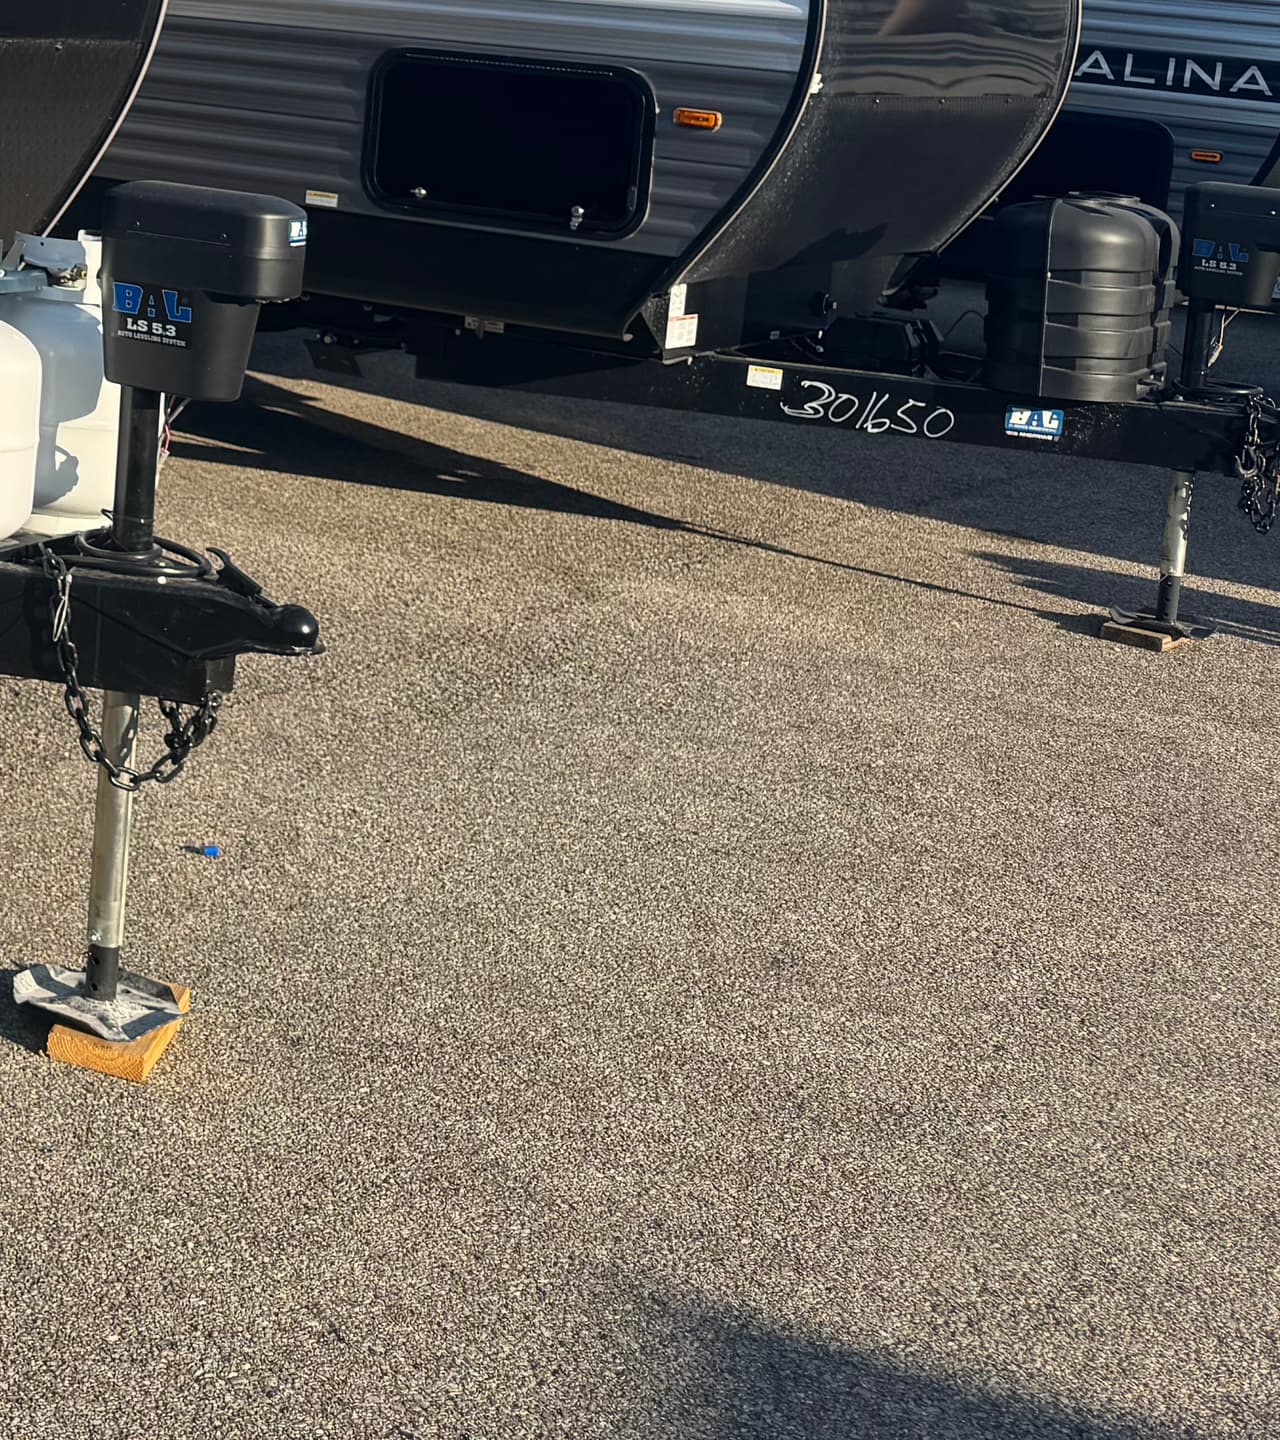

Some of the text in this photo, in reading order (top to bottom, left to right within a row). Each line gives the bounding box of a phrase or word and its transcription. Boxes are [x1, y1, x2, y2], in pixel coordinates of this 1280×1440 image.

[1074, 50, 1274, 96] ALINA
[112, 281, 192, 324] BAL
[126, 317, 177, 337] LS 5.3
[779, 380, 955, 438] 301650
